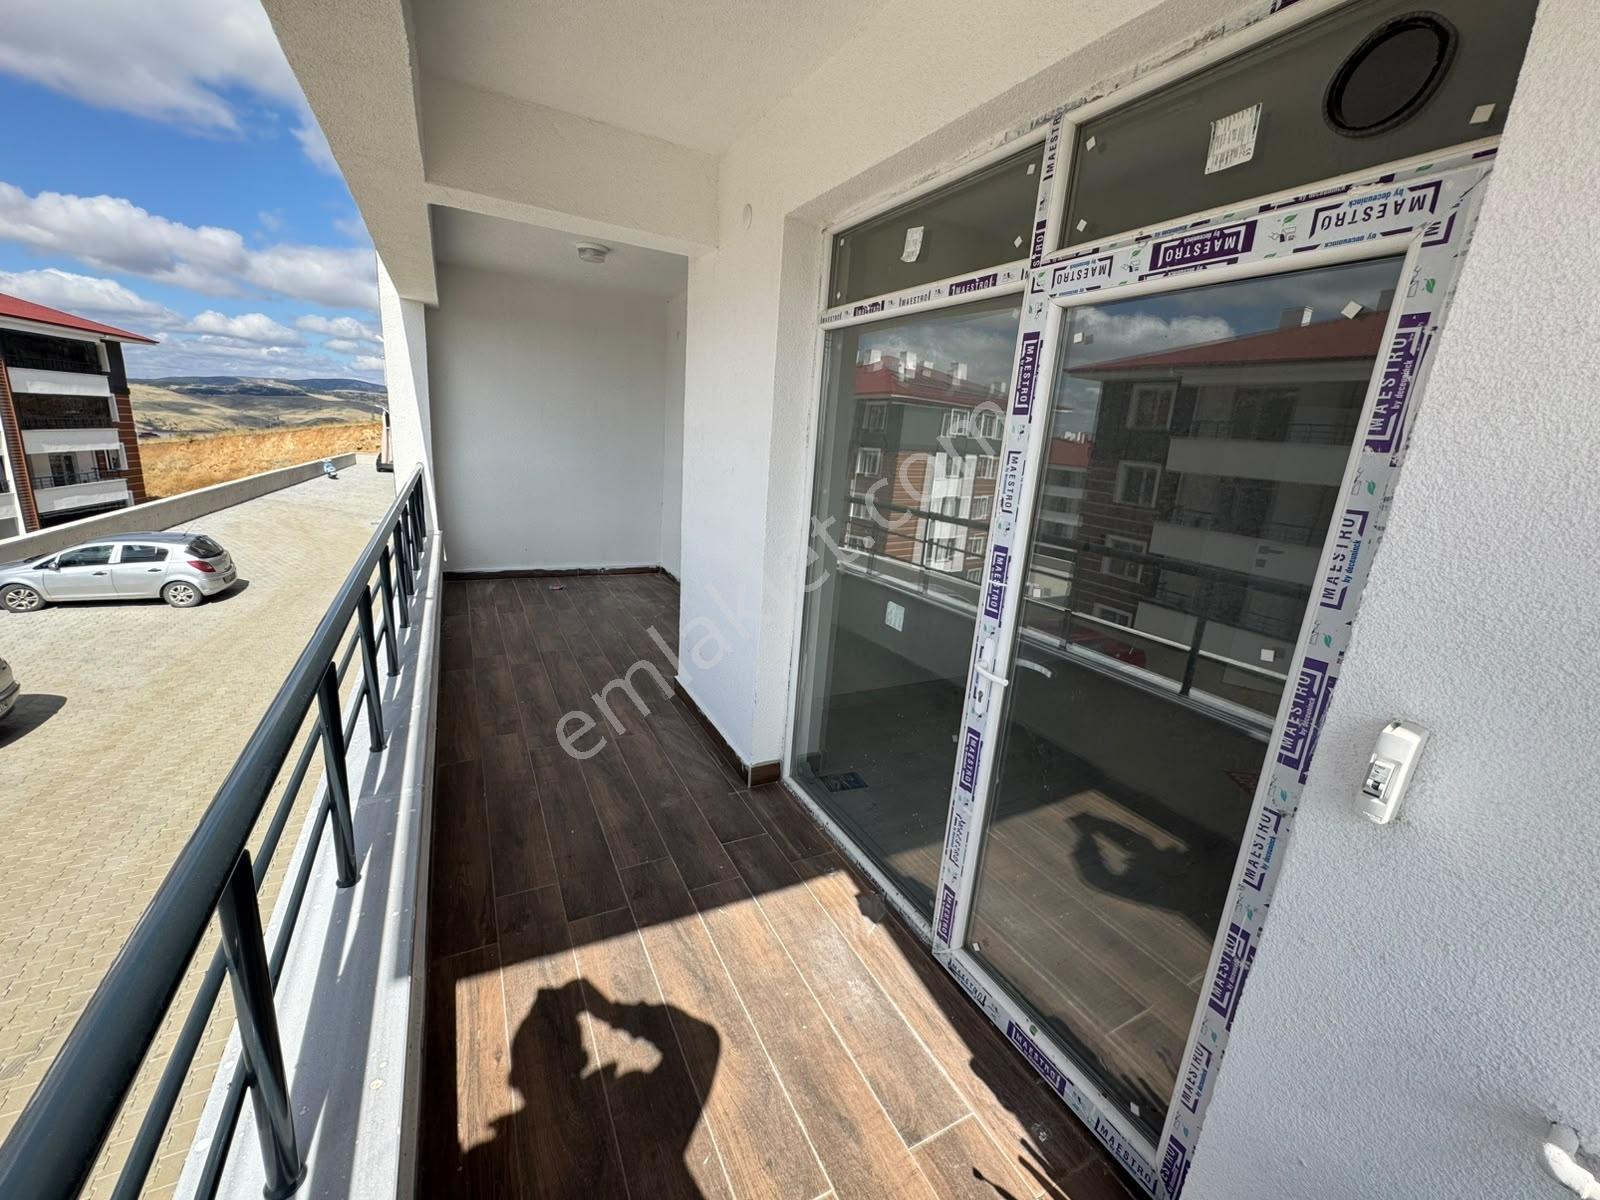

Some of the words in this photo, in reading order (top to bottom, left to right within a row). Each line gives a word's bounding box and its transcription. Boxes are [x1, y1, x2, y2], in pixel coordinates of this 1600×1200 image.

[1321, 194, 1427, 230] MAESTRO
[1057, 263, 1107, 284] MAESTRO
[1166, 235, 1238, 262] MAESTRO
[1019, 345, 1035, 403] MAESTRO
[1369, 337, 1407, 431] MAESTRO
[1004, 456, 1020, 508] MAESTRO
[1323, 518, 1355, 600] MAESTRO
[1281, 674, 1311, 749] MAESTRO
[964, 738, 977, 783] MAESTRO
[1245, 813, 1272, 880] MAESTRO
[1099, 1124, 1151, 1183] MAESTRO
